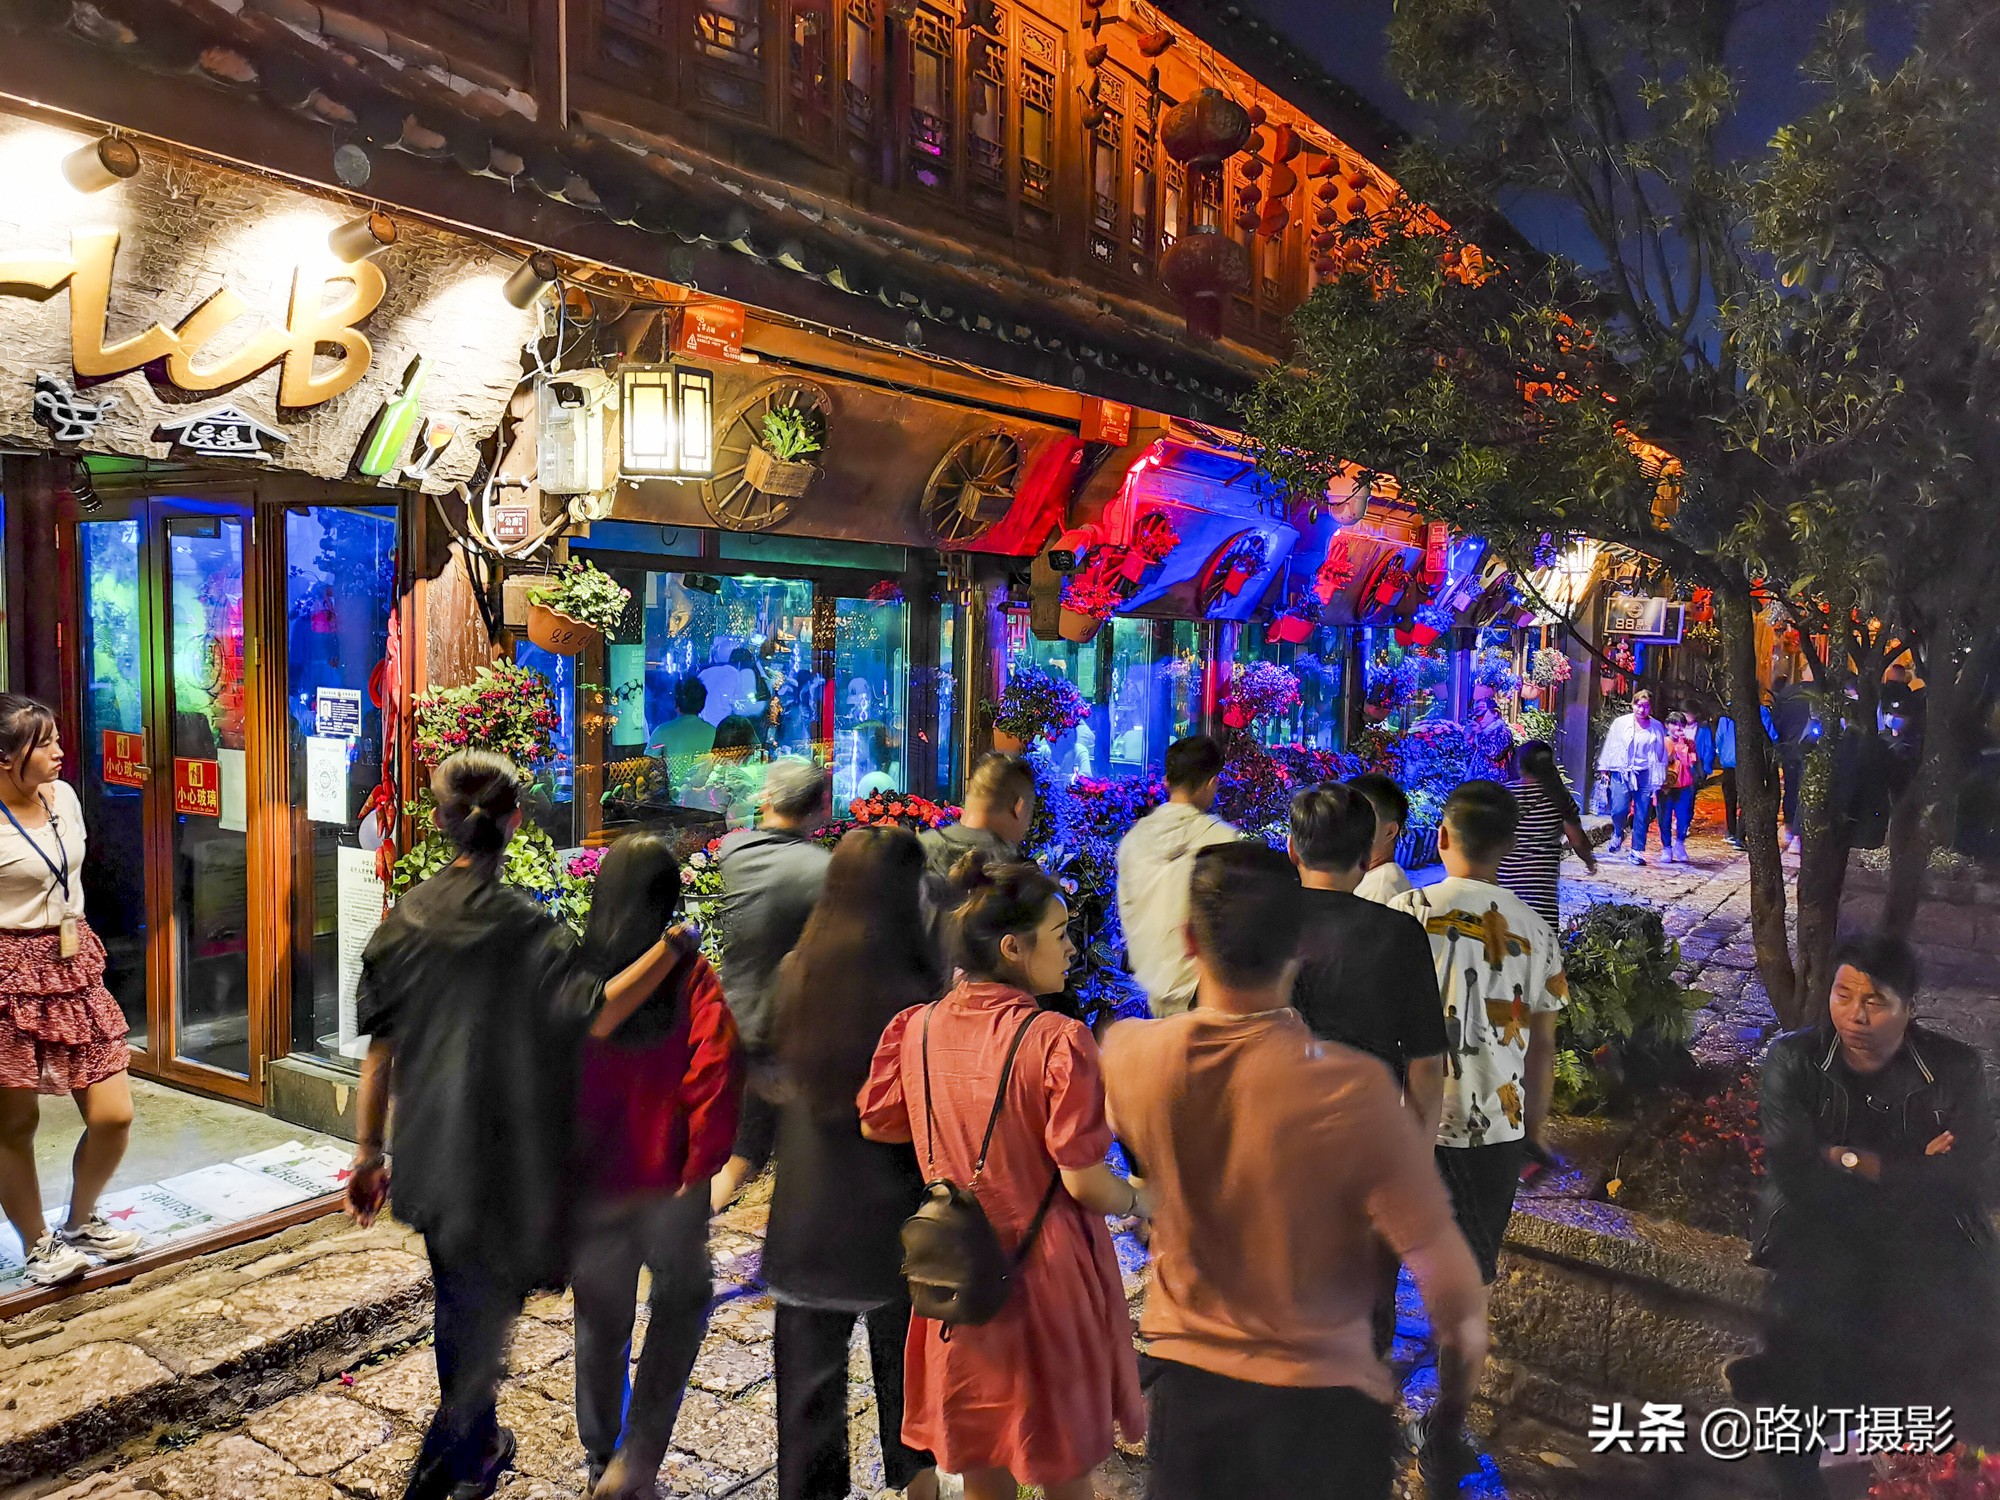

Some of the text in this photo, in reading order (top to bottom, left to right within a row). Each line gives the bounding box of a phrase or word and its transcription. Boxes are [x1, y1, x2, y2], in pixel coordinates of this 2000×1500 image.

[0, 224, 387, 407] LUB
[1615, 618, 1635, 630] 88
[177, 786, 217, 808] 小心玻璃
